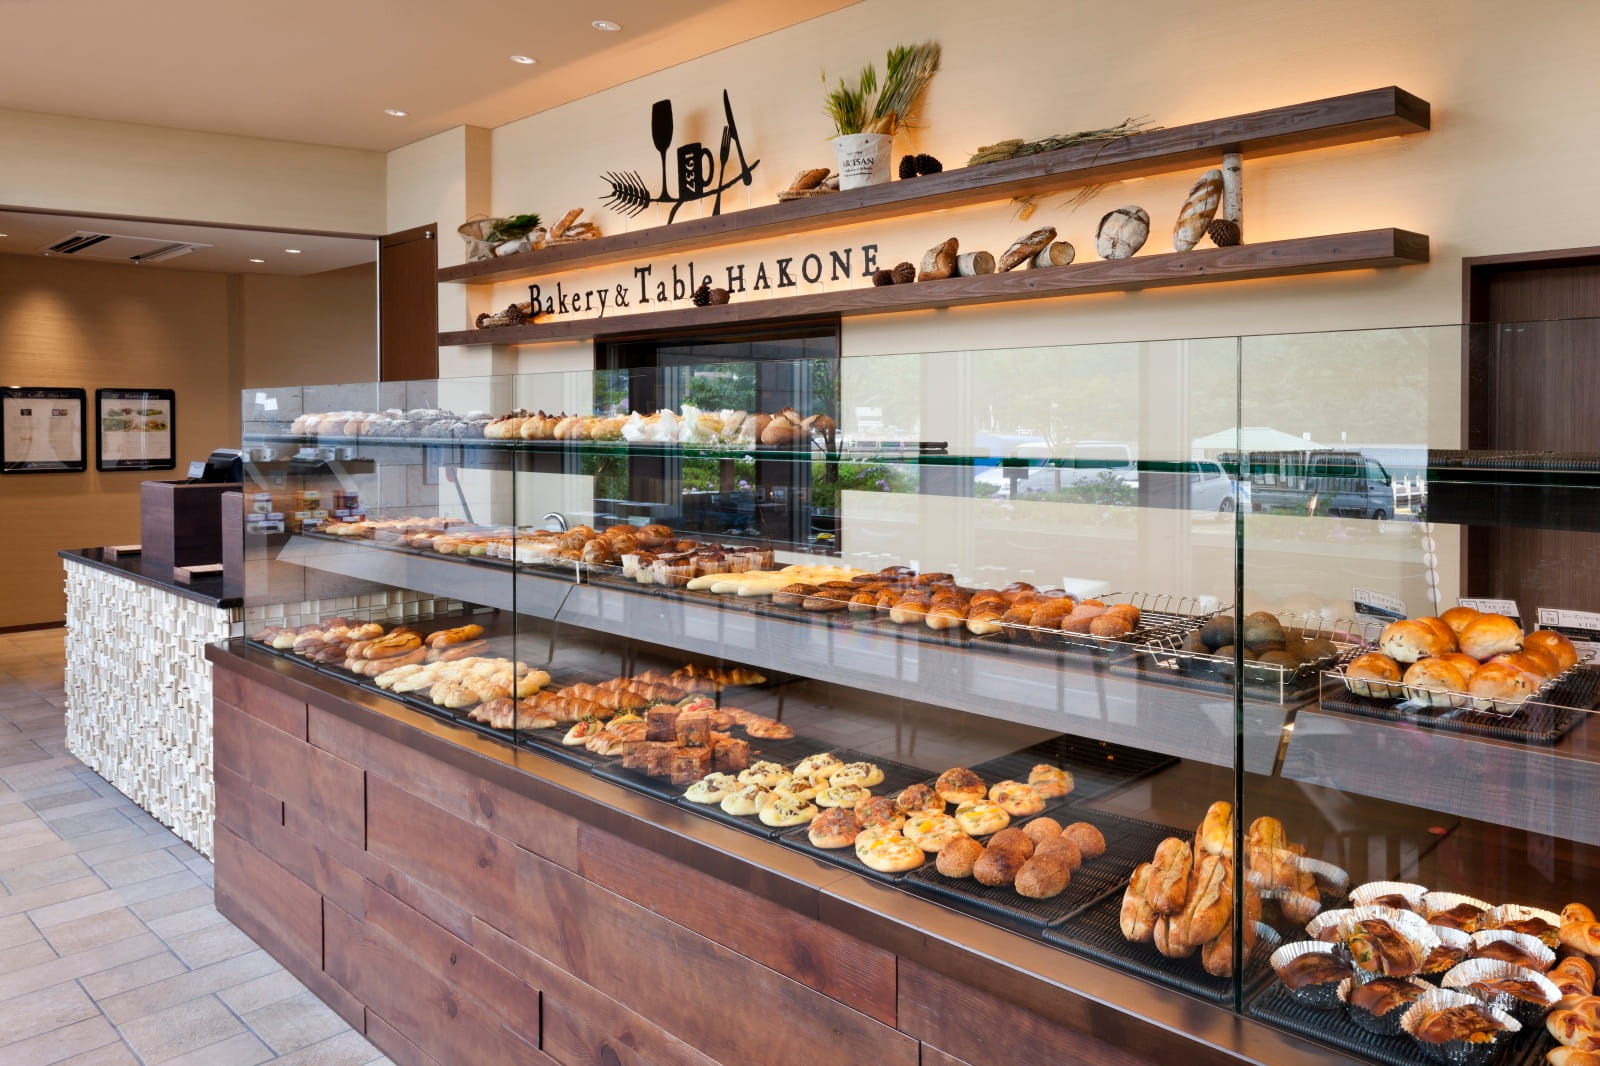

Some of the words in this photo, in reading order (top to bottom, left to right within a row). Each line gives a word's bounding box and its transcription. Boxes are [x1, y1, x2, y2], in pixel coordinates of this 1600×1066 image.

[684, 153, 696, 193] 1937
[528, 281, 609, 319] Bakery
[615, 283, 630, 307] &
[634, 261, 713, 304] Table
[725, 244, 880, 294] HAKONE
